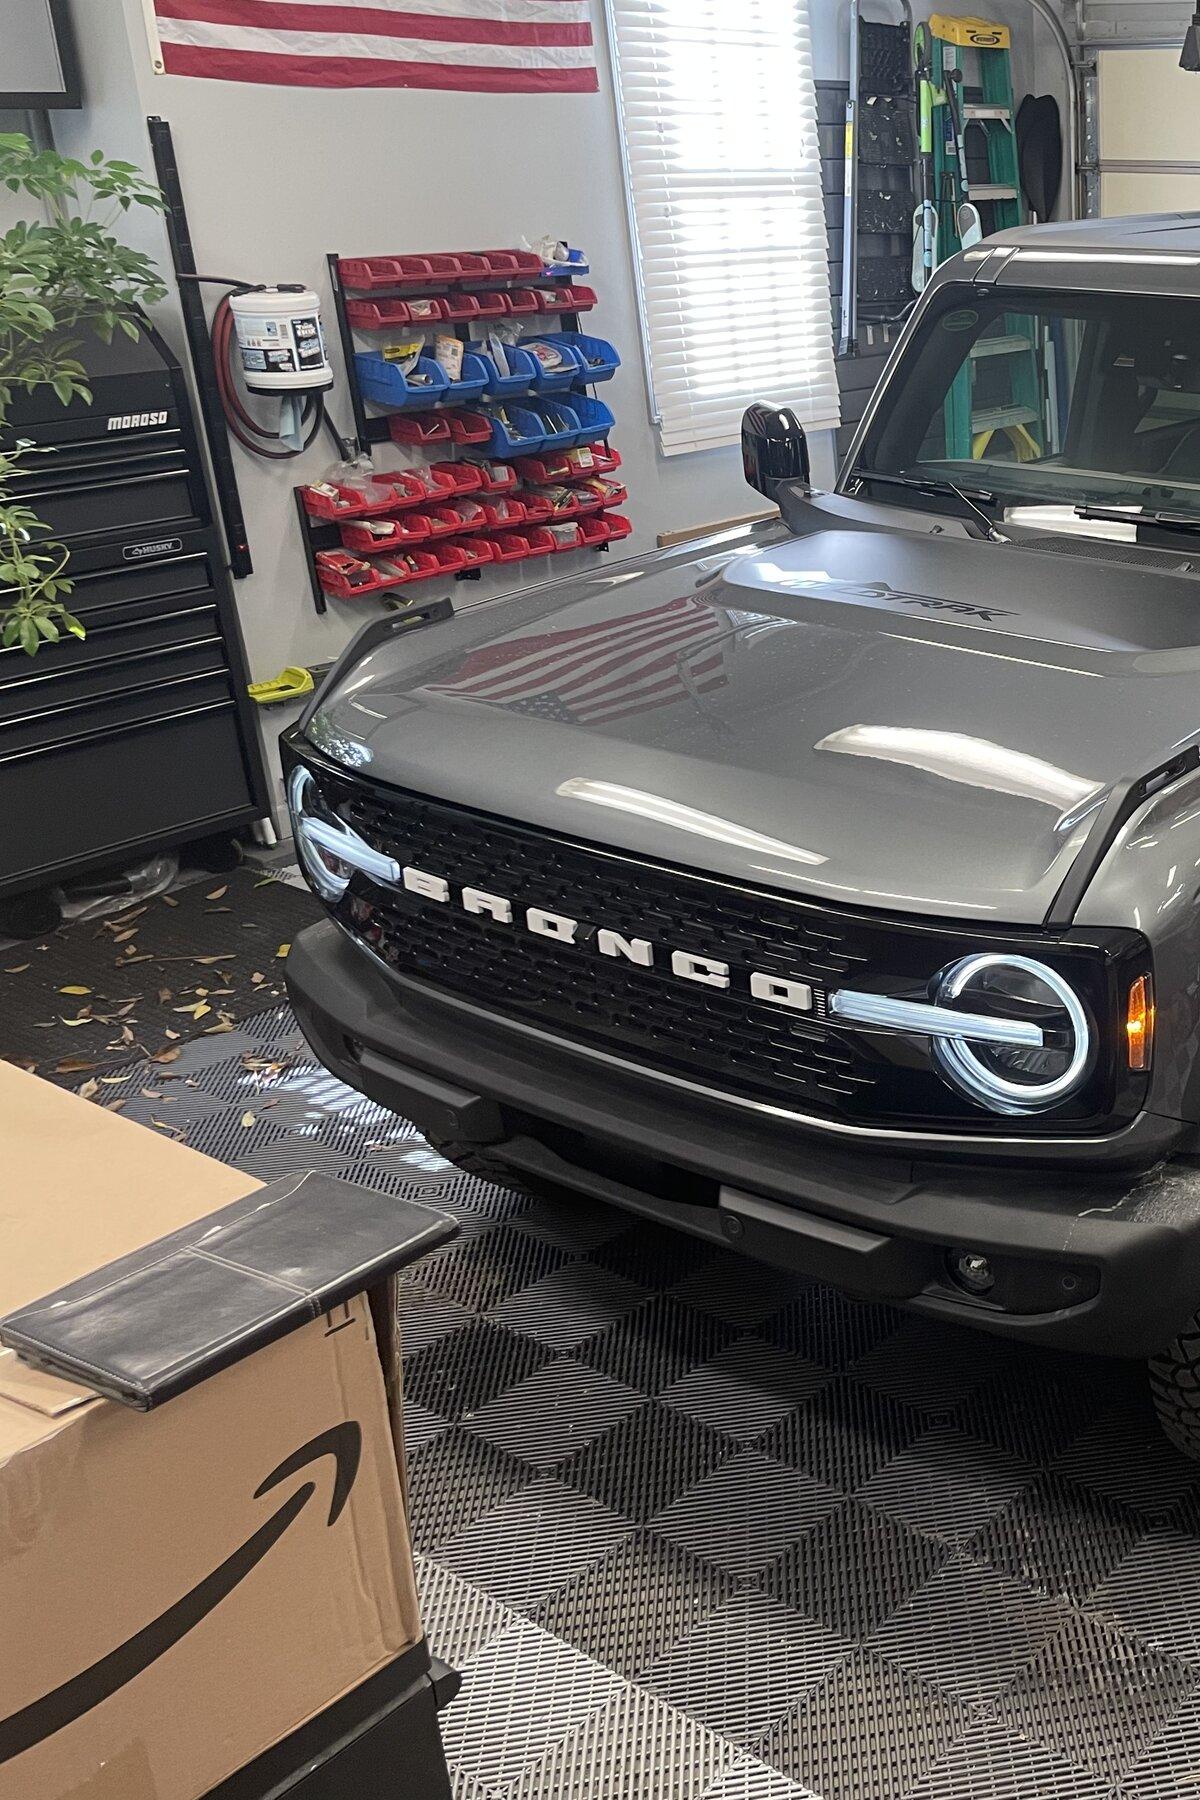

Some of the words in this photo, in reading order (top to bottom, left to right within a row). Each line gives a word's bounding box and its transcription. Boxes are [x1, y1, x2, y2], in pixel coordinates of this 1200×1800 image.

[107, 411, 168, 431] MOROSO
[142, 542, 173, 554] HUSKY
[403, 866, 812, 1010] BRONCO
